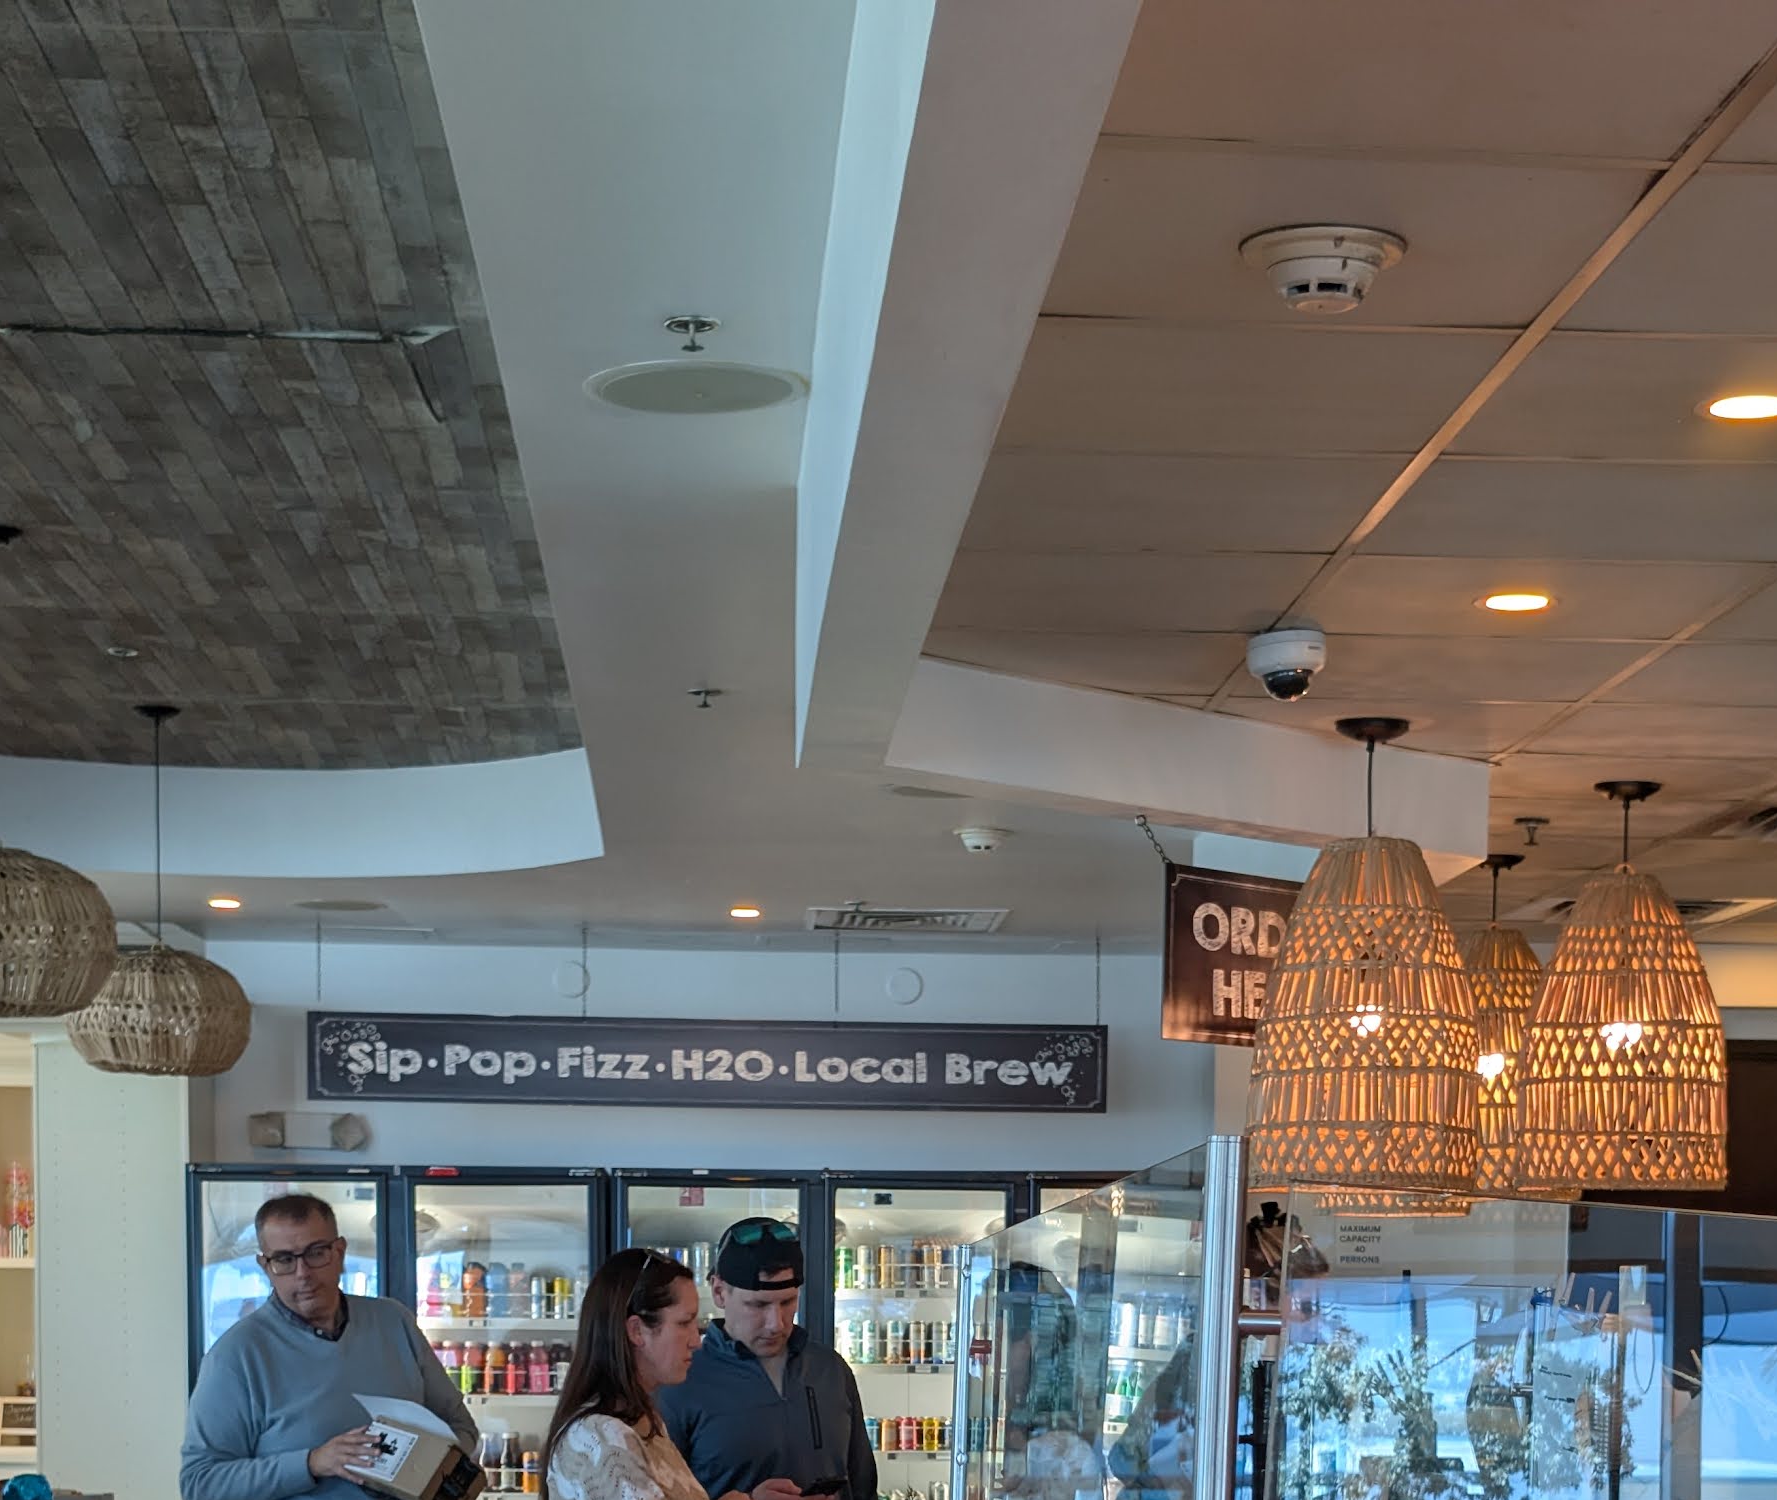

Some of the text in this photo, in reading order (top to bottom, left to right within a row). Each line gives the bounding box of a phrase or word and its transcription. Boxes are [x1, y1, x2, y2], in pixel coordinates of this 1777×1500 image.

[1193, 902, 1288, 957] ORD
[1212, 968, 1267, 1019] HE
[347, 1042, 422, 1082] Sip
[444, 1044, 536, 1084] Pop
[557, 1046, 650, 1079] Fizz
[795, 1051, 927, 1084] Local
[945, 1053, 1073, 1086] Brew
[1339, 1235, 1381, 1243] CAPACITY
[1340, 1256, 1380, 1264] PERSONS
